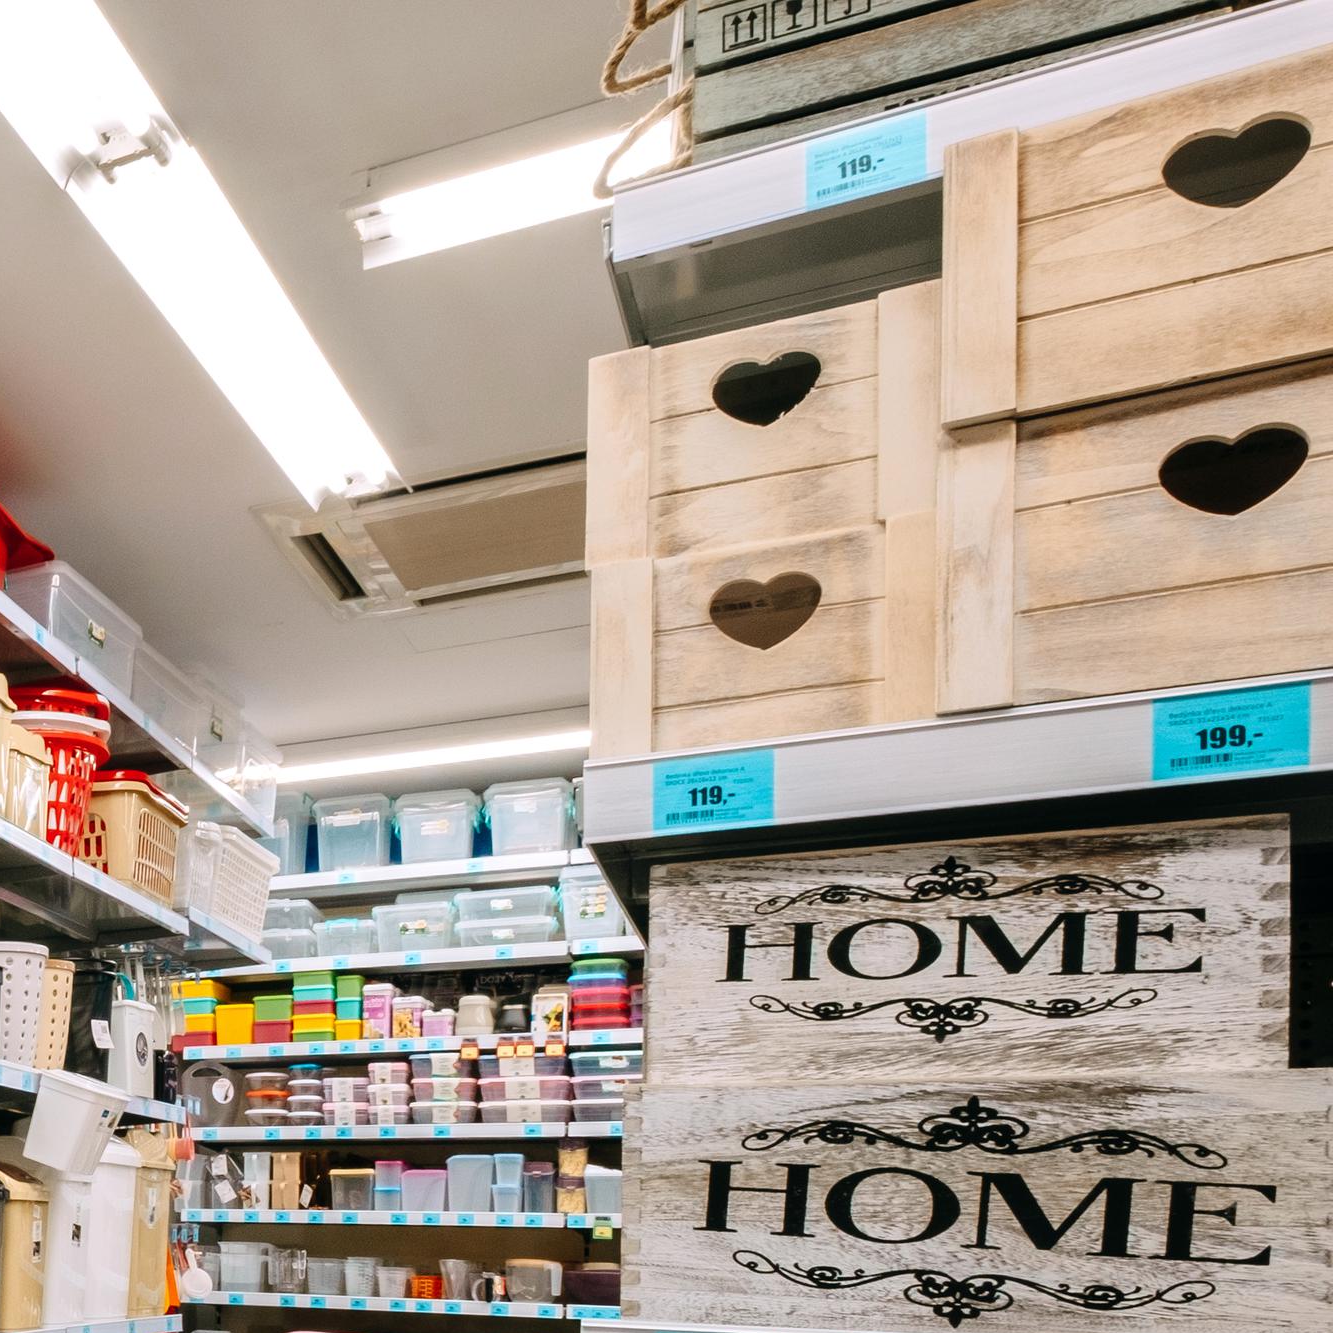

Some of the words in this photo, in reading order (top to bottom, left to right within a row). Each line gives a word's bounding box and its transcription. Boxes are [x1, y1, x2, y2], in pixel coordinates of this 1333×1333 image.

[838, 154, 885, 179] 119,-
[1195, 724, 1263, 750] 199,-
[688, 785, 736, 806] 119,-
[716, 908, 1206, 983] HOME
[693, 1159, 1277, 1266] HOME
